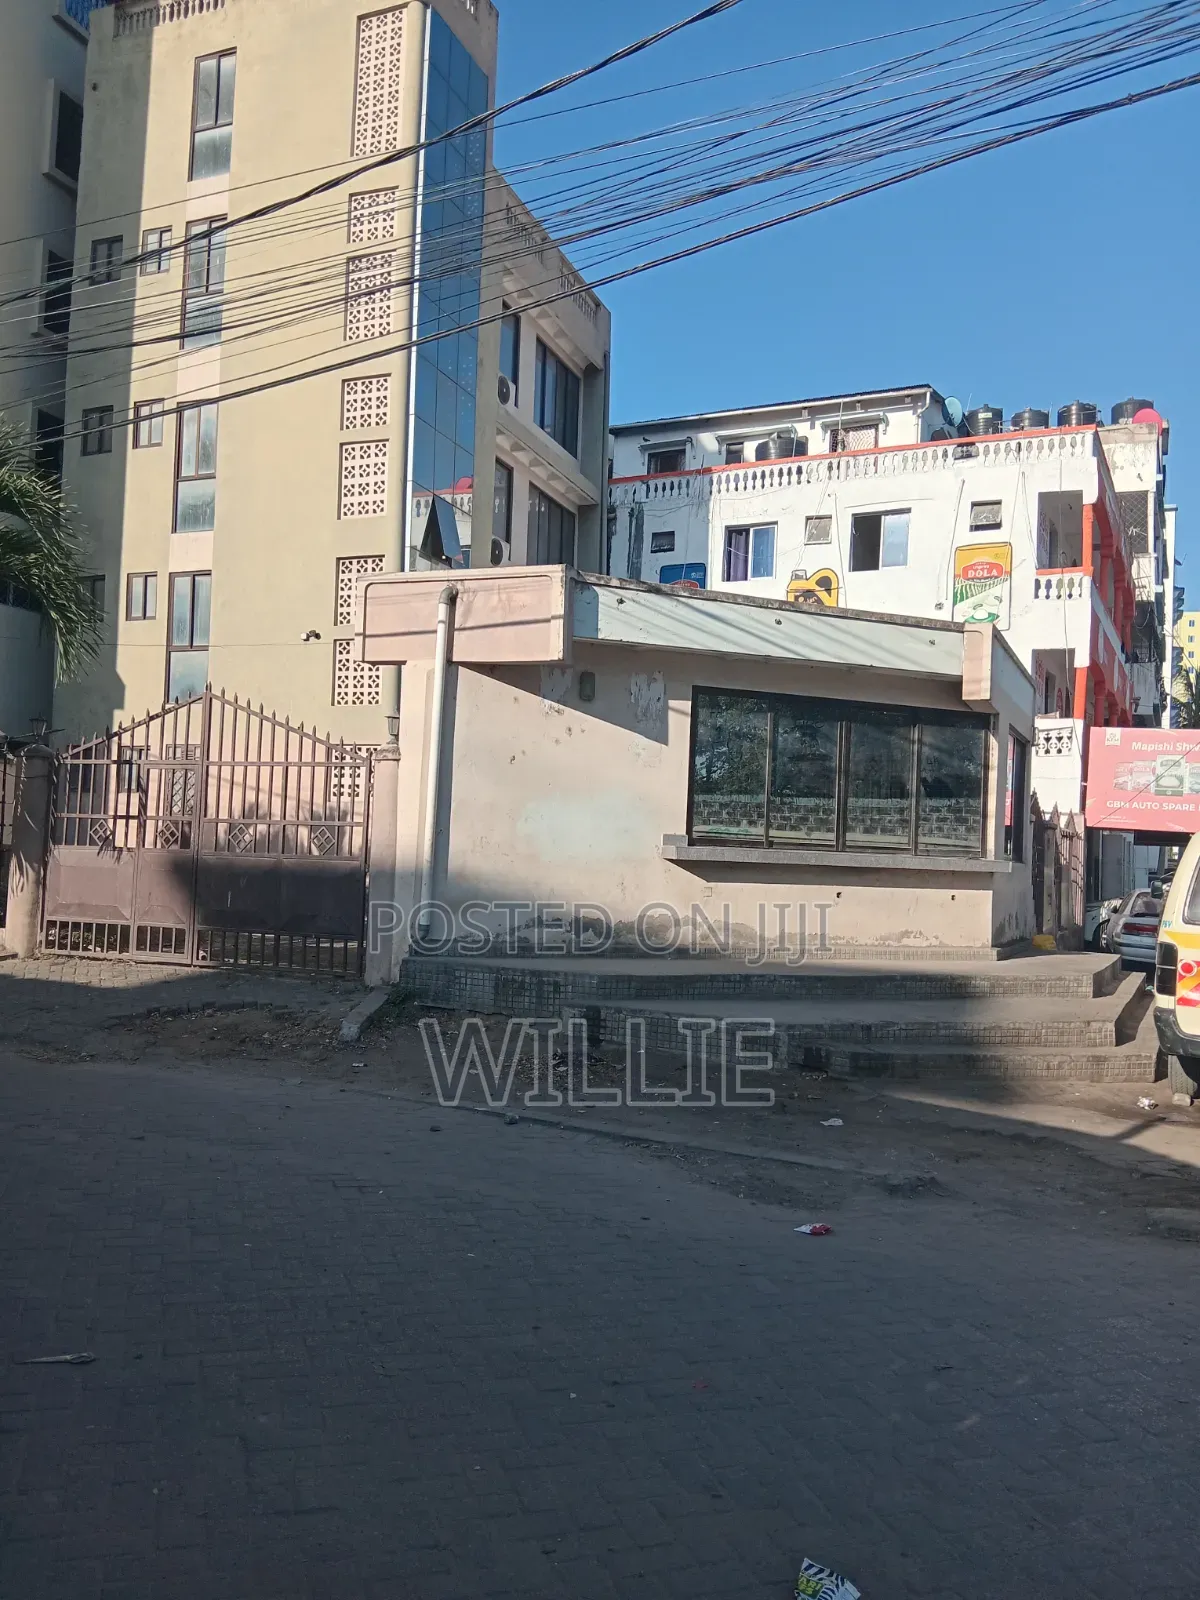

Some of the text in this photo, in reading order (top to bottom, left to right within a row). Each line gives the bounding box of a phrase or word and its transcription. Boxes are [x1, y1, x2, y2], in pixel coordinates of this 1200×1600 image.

[967, 569, 998, 577] DOLA
[1131, 742, 1200, 752] Mapishi Shw
[1106, 800, 1129, 809] GBM
[1132, 801, 1160, 810] AUTO
[1162, 802, 1196, 811] SPARE
